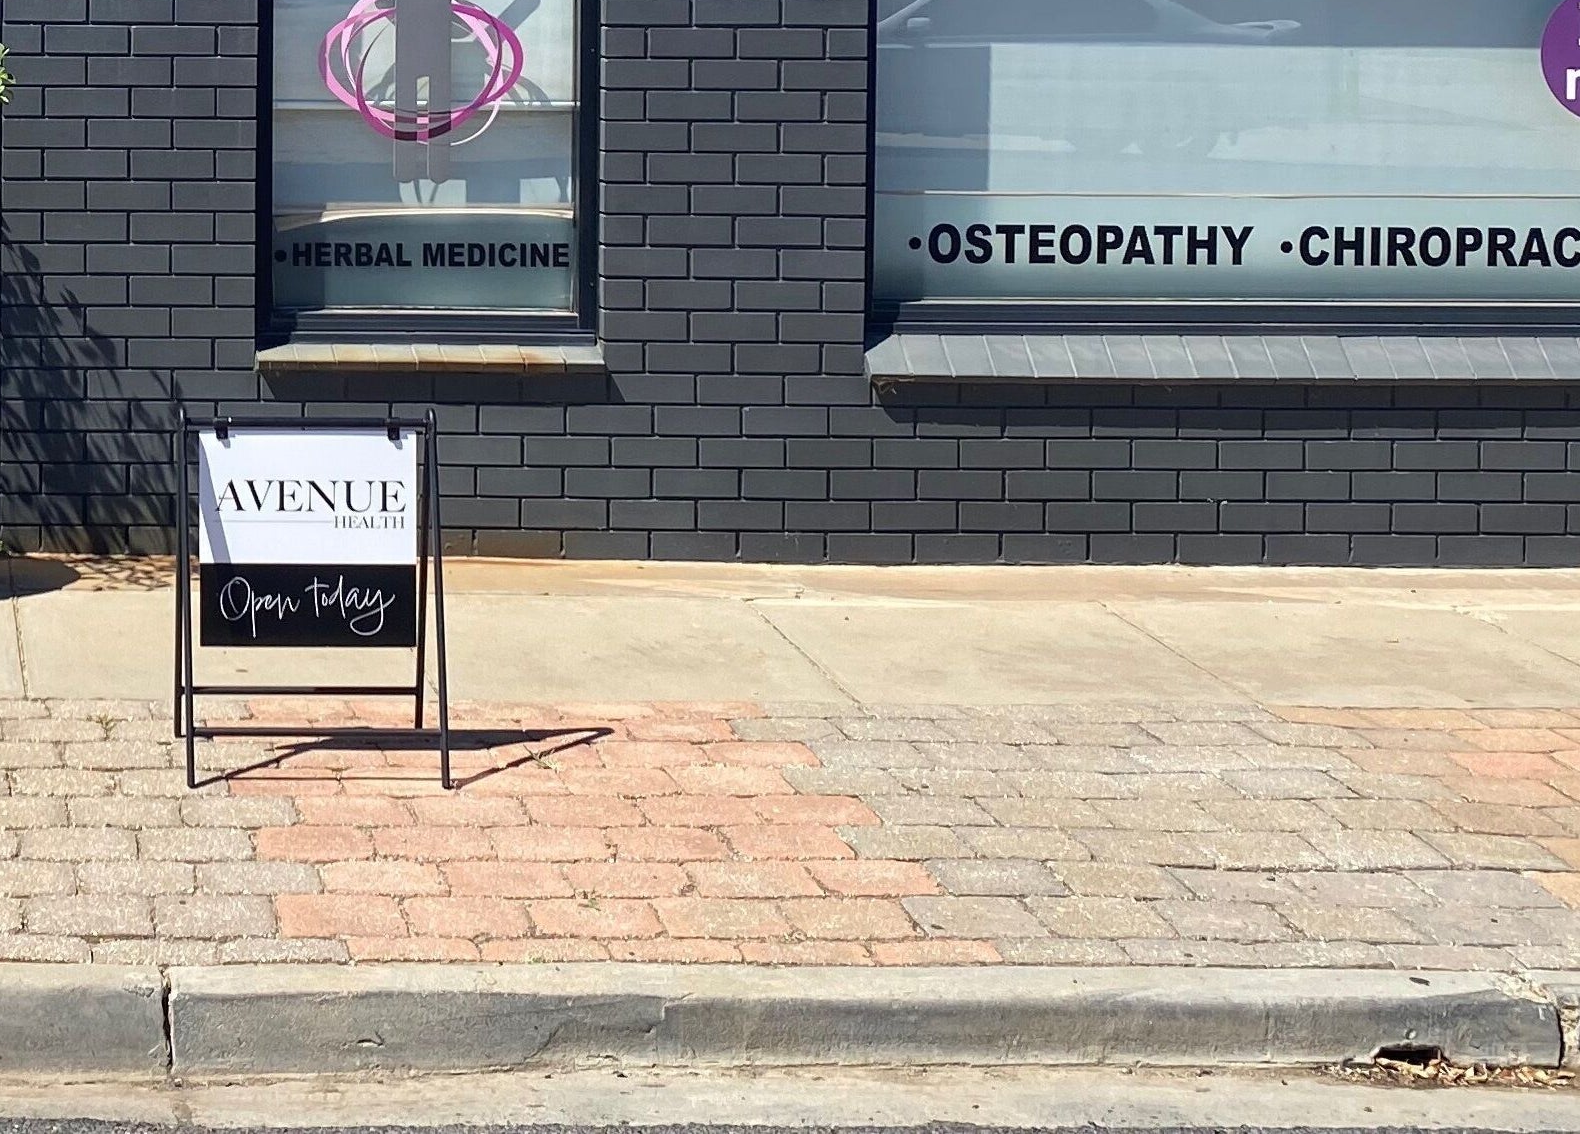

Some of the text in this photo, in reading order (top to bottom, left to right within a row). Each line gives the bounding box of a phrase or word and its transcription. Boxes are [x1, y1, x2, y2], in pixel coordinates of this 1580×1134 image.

[292, 242, 570, 268] HERBAL MEDICINE
[928, 223, 1580, 268] OSTEOPATHY CHIROPRAC
[215, 478, 407, 513] AVENUE
[333, 515, 405, 529] HEALTH
[219, 574, 396, 639] Open today
